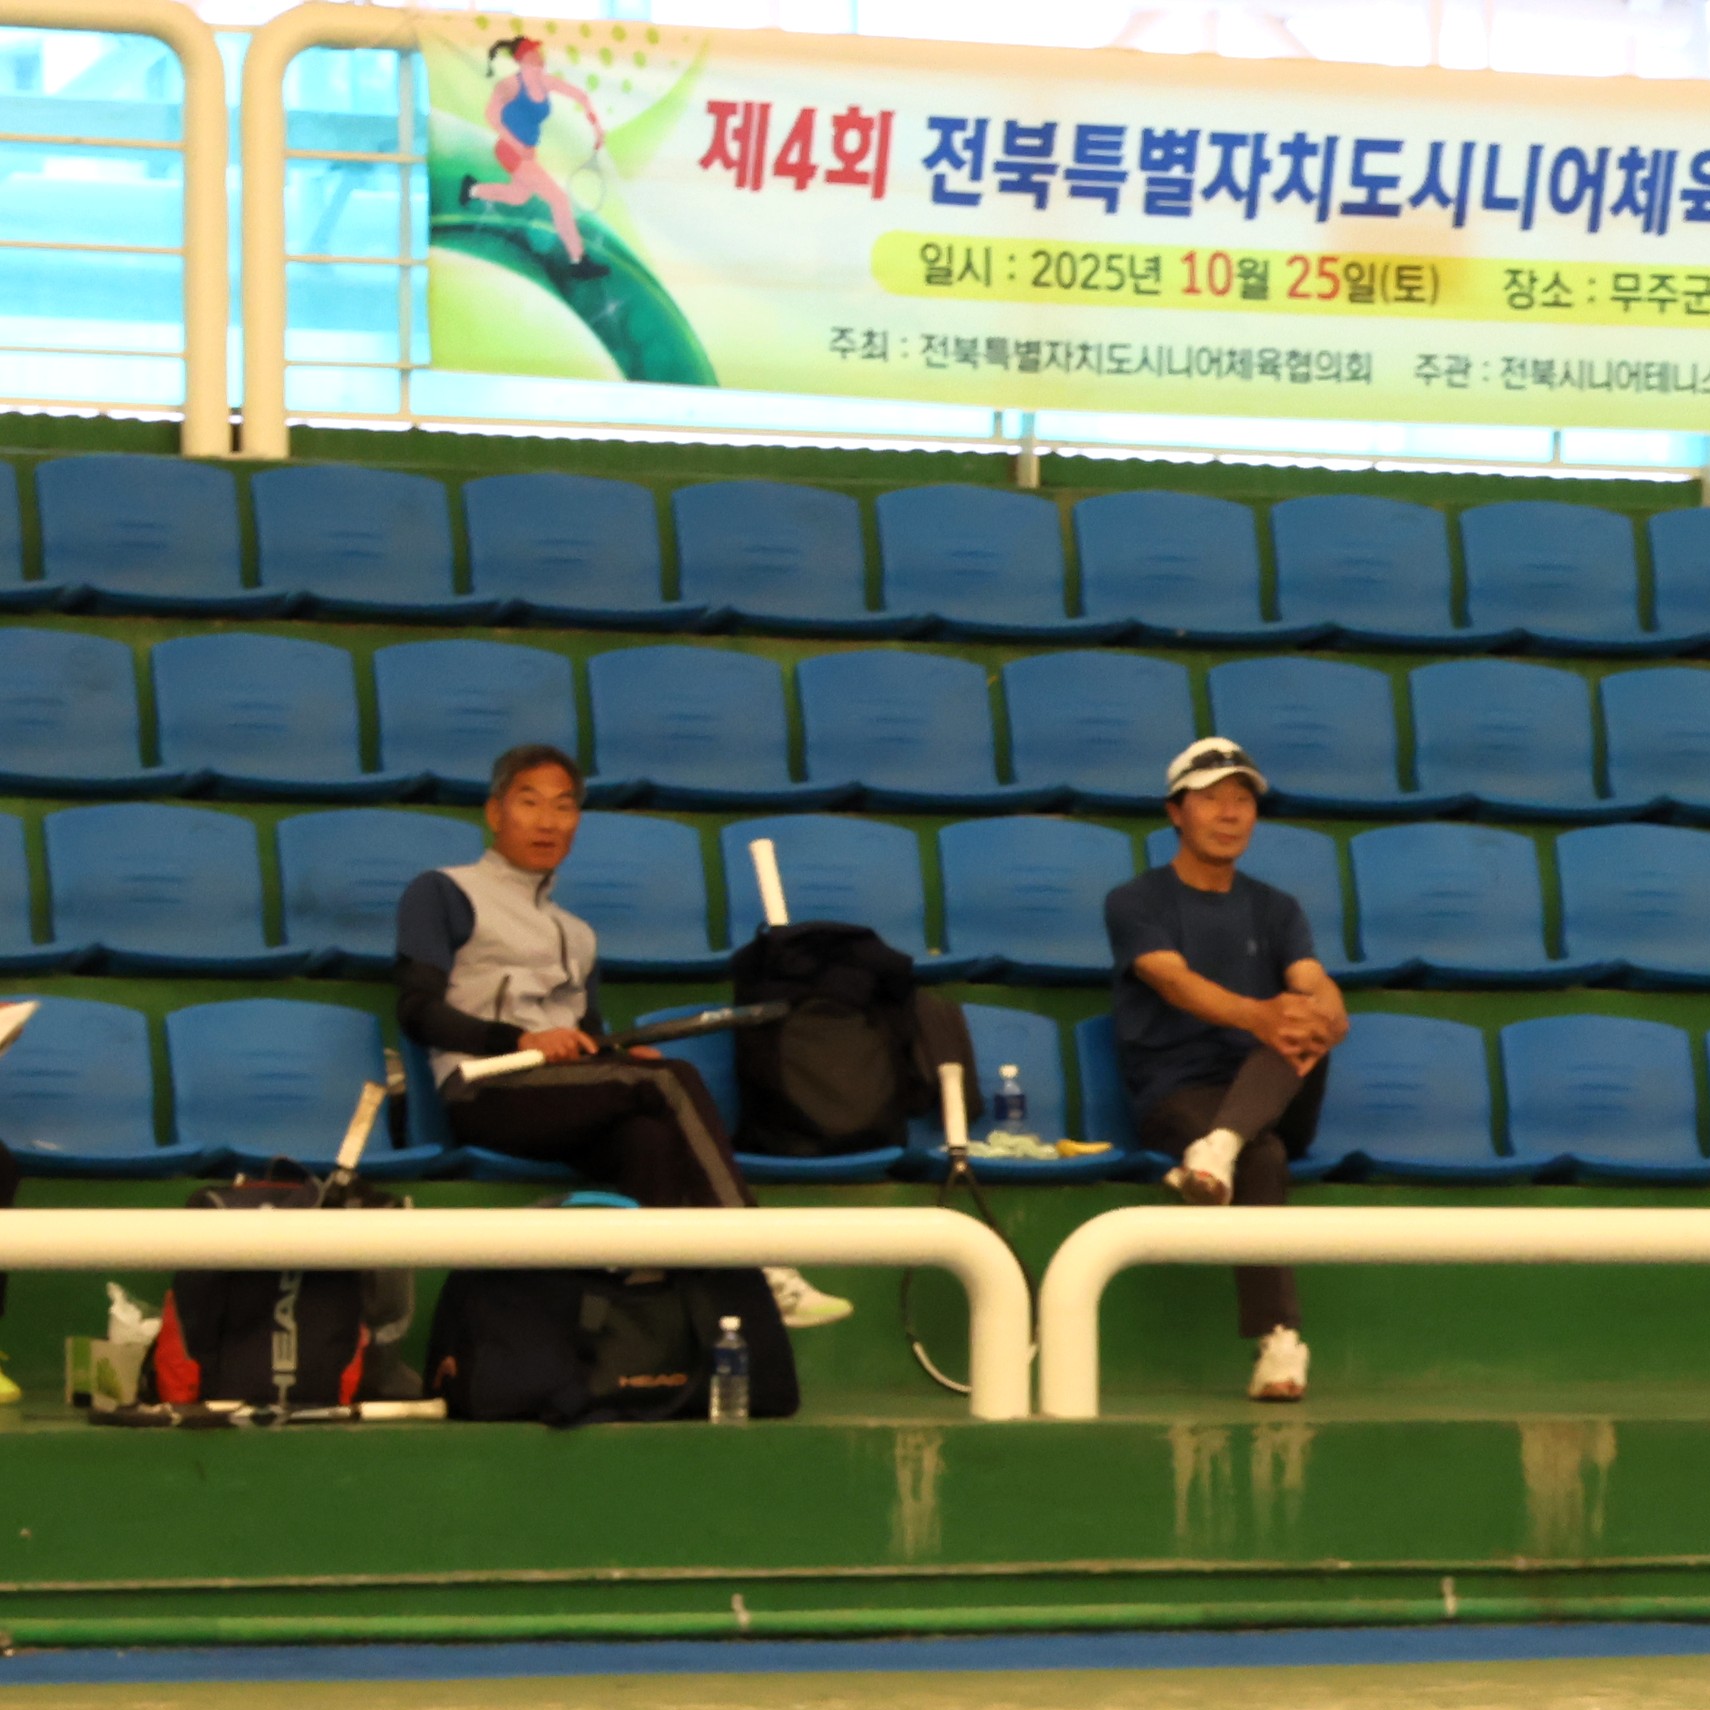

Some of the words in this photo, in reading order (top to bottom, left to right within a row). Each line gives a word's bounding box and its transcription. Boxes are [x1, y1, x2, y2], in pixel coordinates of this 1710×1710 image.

[698, 99, 896, 200] 제4회
[919, 242, 991, 287] 일시
[1030, 249, 1162, 296] 2025년
[1180, 250, 1270, 301] 10월
[1286, 254, 1441, 306] 25일(토)
[1502, 267, 1574, 310] 장소
[828, 326, 889, 362] 주최
[920, 332, 1373, 384] 전북특별자치도시니어체육협의회
[1414, 353, 1472, 388] 주관
